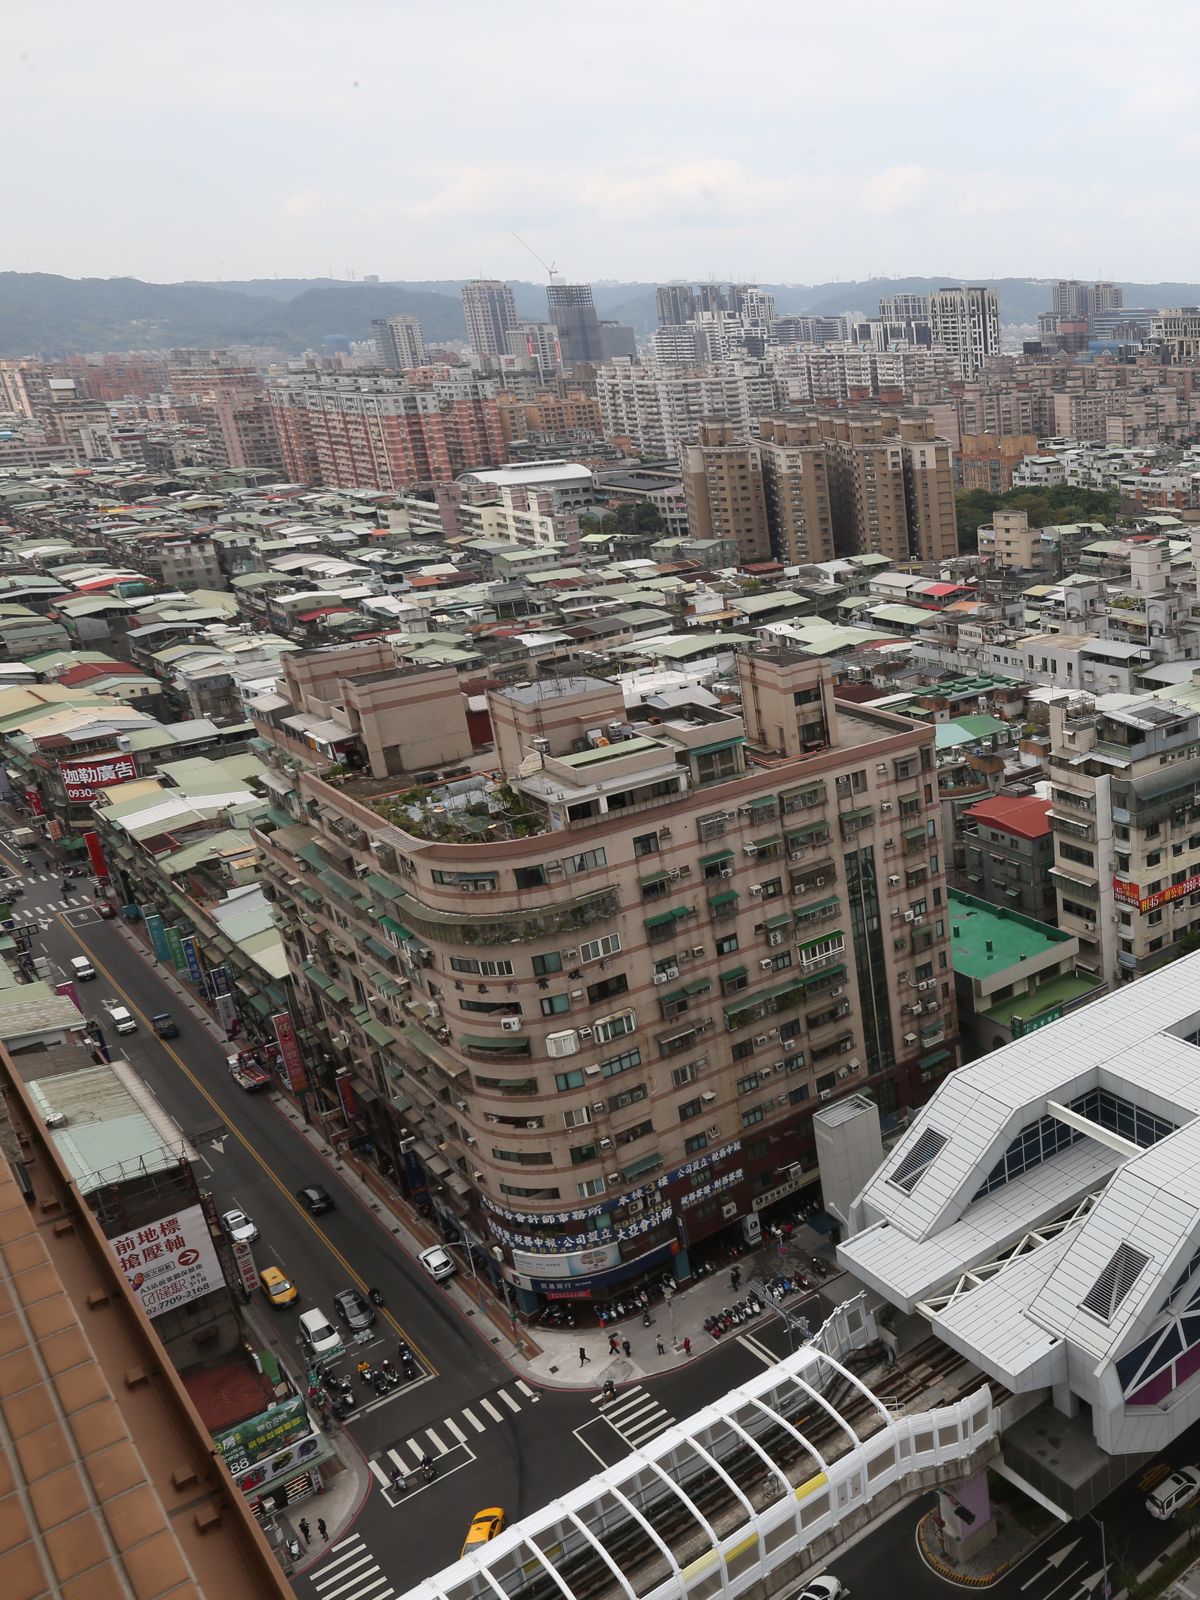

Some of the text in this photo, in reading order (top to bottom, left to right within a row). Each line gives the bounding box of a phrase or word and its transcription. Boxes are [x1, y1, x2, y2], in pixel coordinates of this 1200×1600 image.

[62, 761, 134, 785] 迦勒廣告
[113, 1217, 181, 1256] 前地標
[120, 1235, 186, 1272] 搶壓軸
[146, 1282, 210, 1315] 02.7709-2168
